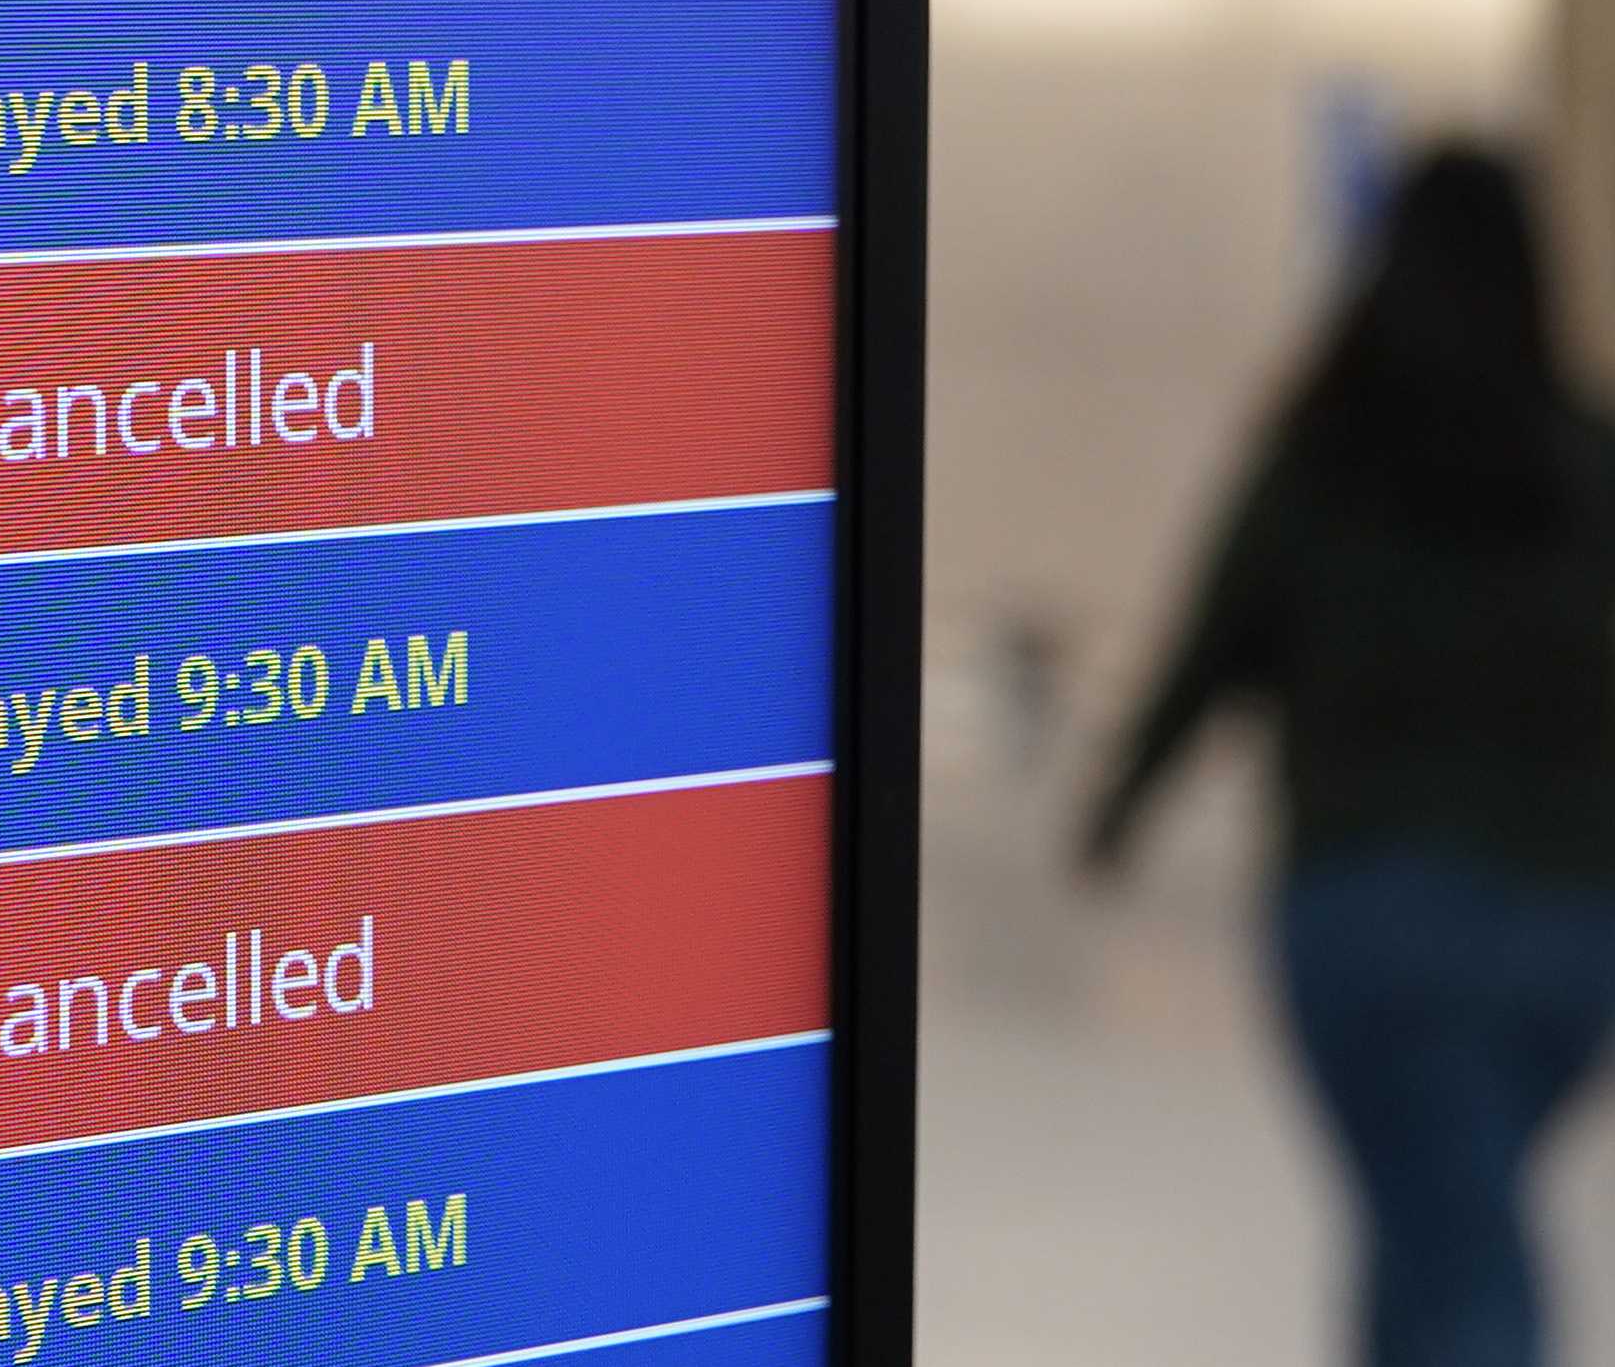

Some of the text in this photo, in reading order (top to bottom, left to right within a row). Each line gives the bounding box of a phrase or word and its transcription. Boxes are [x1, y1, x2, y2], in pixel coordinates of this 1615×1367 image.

[177, 63, 328, 141] 8:30
[352, 60, 469, 136] AM
[178, 645, 328, 730] 9:30
[352, 631, 467, 714] AM
[179, 1218, 328, 1308] 9:30
[351, 1194, 466, 1282] AM
